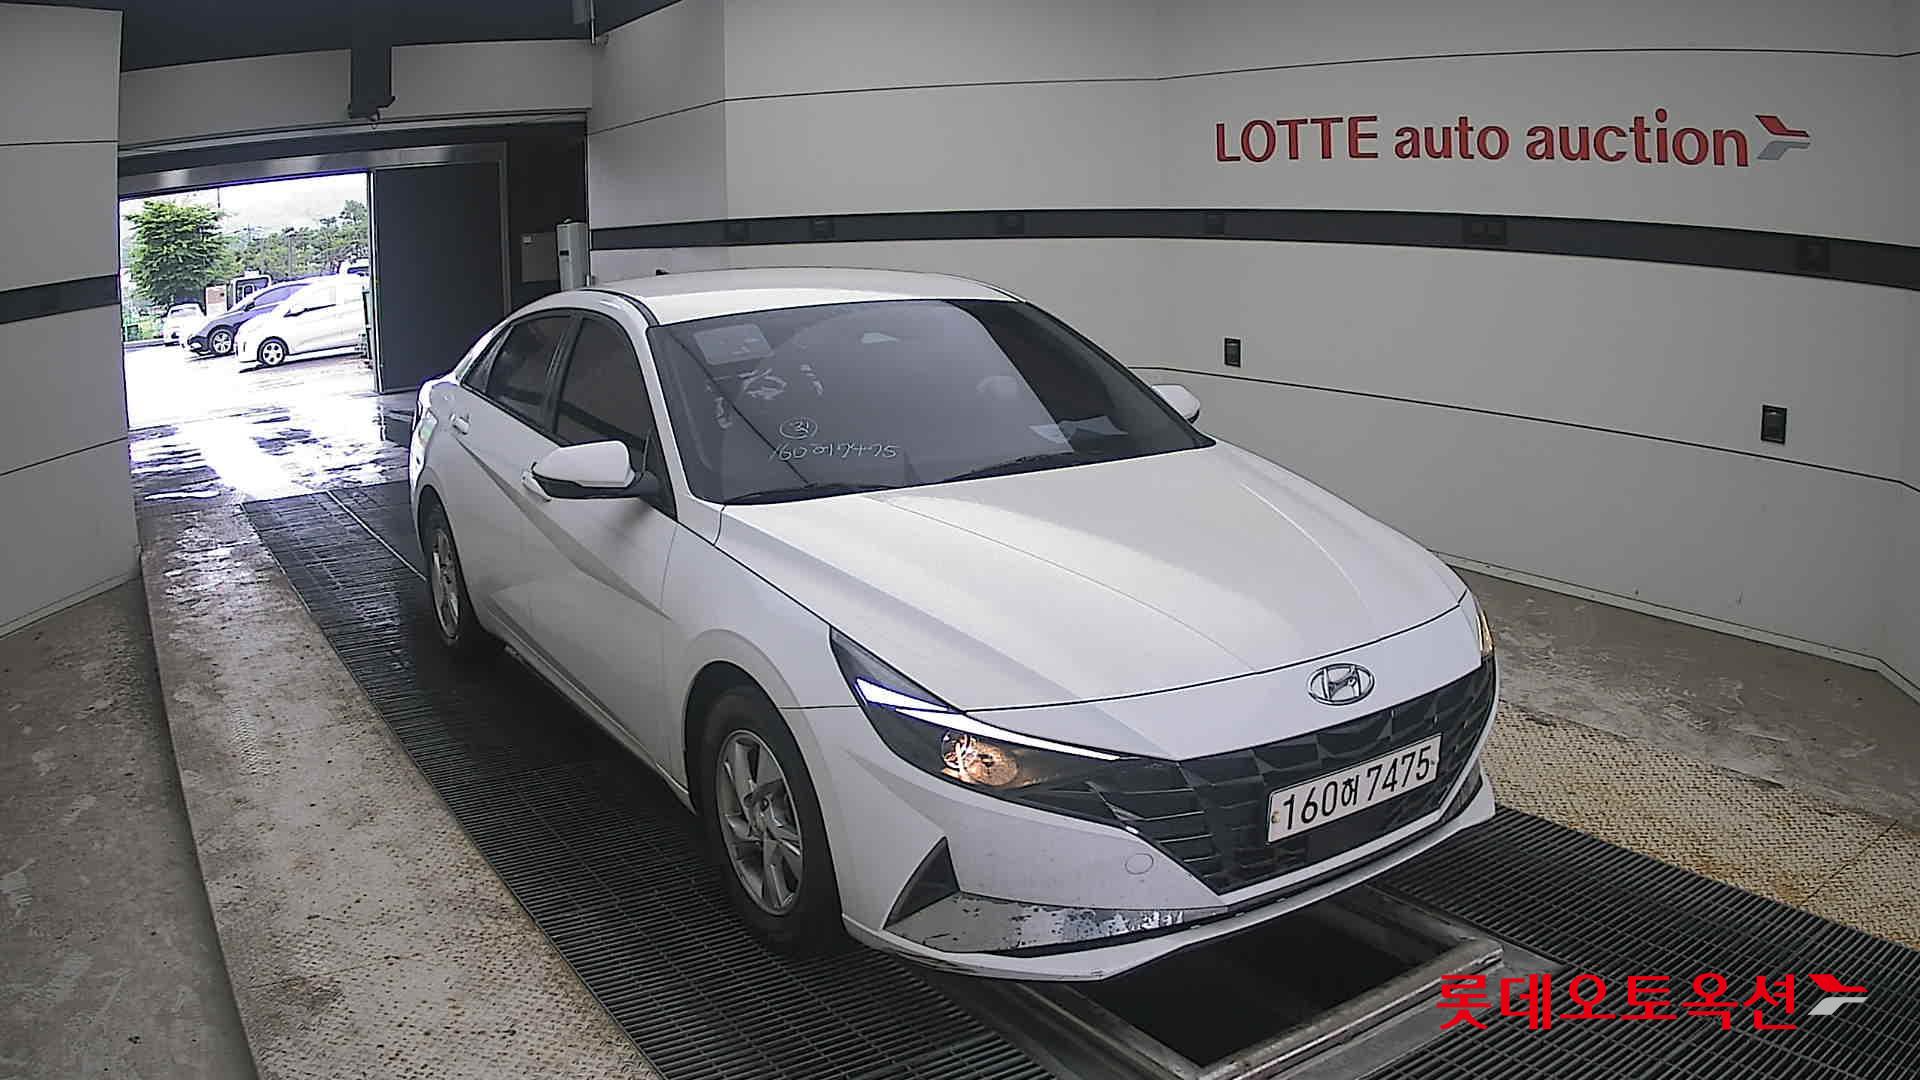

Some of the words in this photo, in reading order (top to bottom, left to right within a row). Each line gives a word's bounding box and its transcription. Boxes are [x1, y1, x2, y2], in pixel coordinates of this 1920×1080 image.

[1216, 115, 1379, 162] LOTTE
[1393, 116, 1510, 160] auto
[1525, 108, 1750, 167] auction
[1283, 774, 1360, 830] 160허
[1366, 745, 1432, 802] 7475
